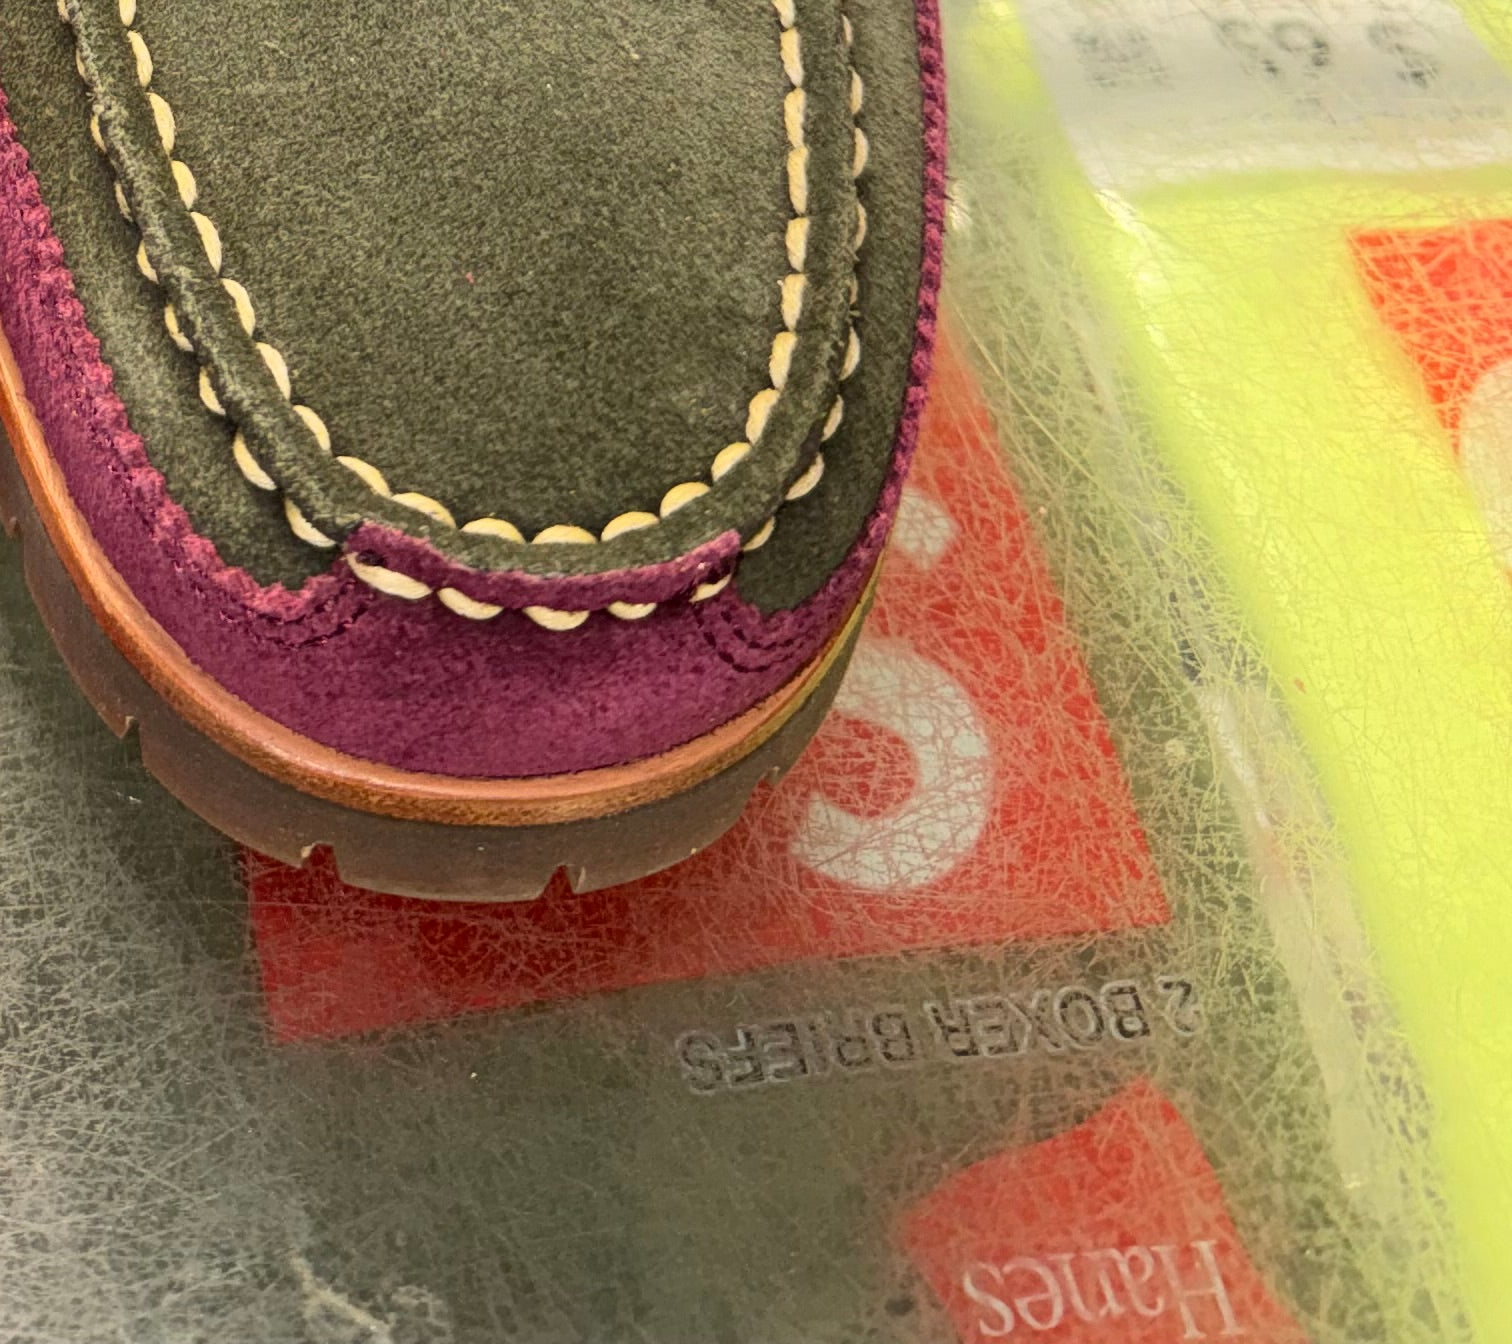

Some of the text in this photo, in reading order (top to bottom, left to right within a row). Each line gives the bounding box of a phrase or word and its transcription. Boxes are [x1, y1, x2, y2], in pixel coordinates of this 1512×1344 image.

[675, 975, 1206, 1095] 2 BOXER BRIEFS
[963, 1239, 1246, 1339] Hanes
